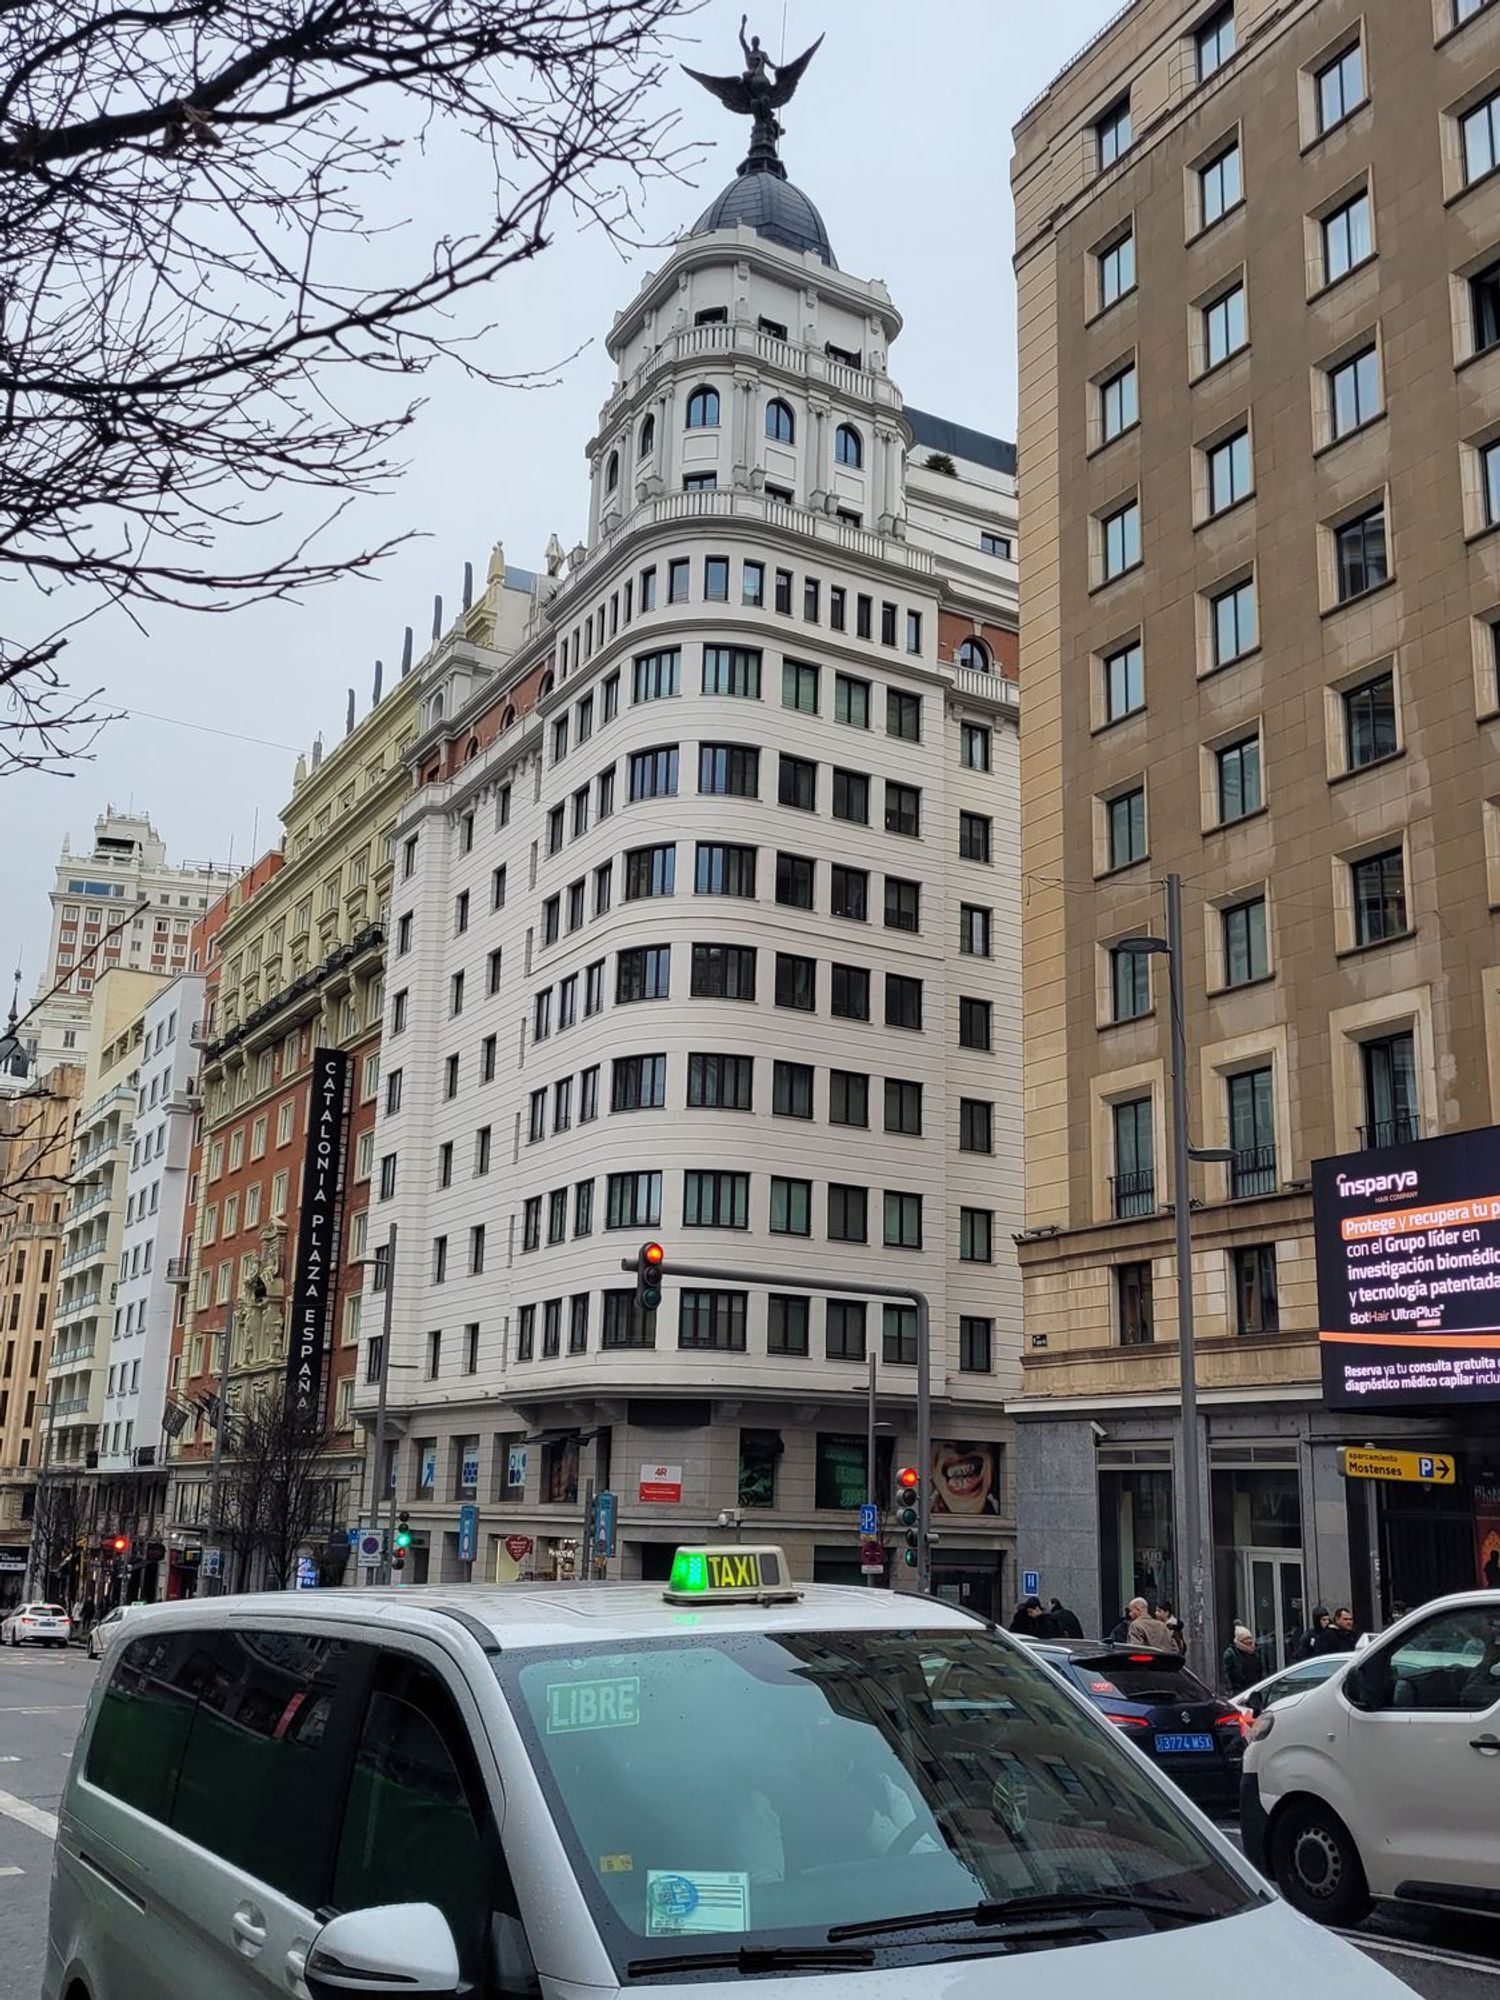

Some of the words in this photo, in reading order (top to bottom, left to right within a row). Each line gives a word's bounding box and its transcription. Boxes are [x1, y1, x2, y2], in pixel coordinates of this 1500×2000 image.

[314, 1062, 336, 1202] CATALONIA
[1336, 1170, 1418, 1197] insparya
[1389, 1191, 1418, 1202] COMPANY
[1345, 1217, 1396, 1236] Protege
[1398, 1215, 1406, 1232] y
[1409, 1206, 1469, 1227] recupera
[1472, 1202, 1488, 1217] tu
[305, 1215, 325, 1297] PLAZA
[1346, 1243, 1370, 1258] con
[1371, 1238, 1383, 1254] el
[1385, 1235, 1426, 1253] Grupo
[1428, 1229, 1459, 1247] líder
[1462, 1228, 1480, 1243] en
[1347, 1255, 1435, 1281] investigación
[1349, 1290, 1358, 1308] y
[1358, 1279, 1428, 1303] tecnología
[1350, 1309, 1390, 1325] BotHair
[296, 1309, 315, 1408] ESPAÑA
[1344, 1365, 1382, 1377] Reserva
[1384, 1365, 1395, 1379] ya
[1397, 1362, 1407, 1374] tu
[1409, 1359, 1452, 1374] consulta
[1453, 1356, 1496, 1374] gratuita
[1345, 1375, 1400, 1394] diagnóstico
[1401, 1374, 1437, 1388] médico
[1439, 1373, 1474, 1389] capilar
[1349, 1453, 1398, 1463] aparcamiento
[1349, 1461, 1403, 1476] Mostenses
[1421, 1458, 1432, 1476] P
[864, 1509, 874, 1529] P
[708, 1555, 758, 1587] TAXI
[553, 1684, 634, 1726] LIBRE
